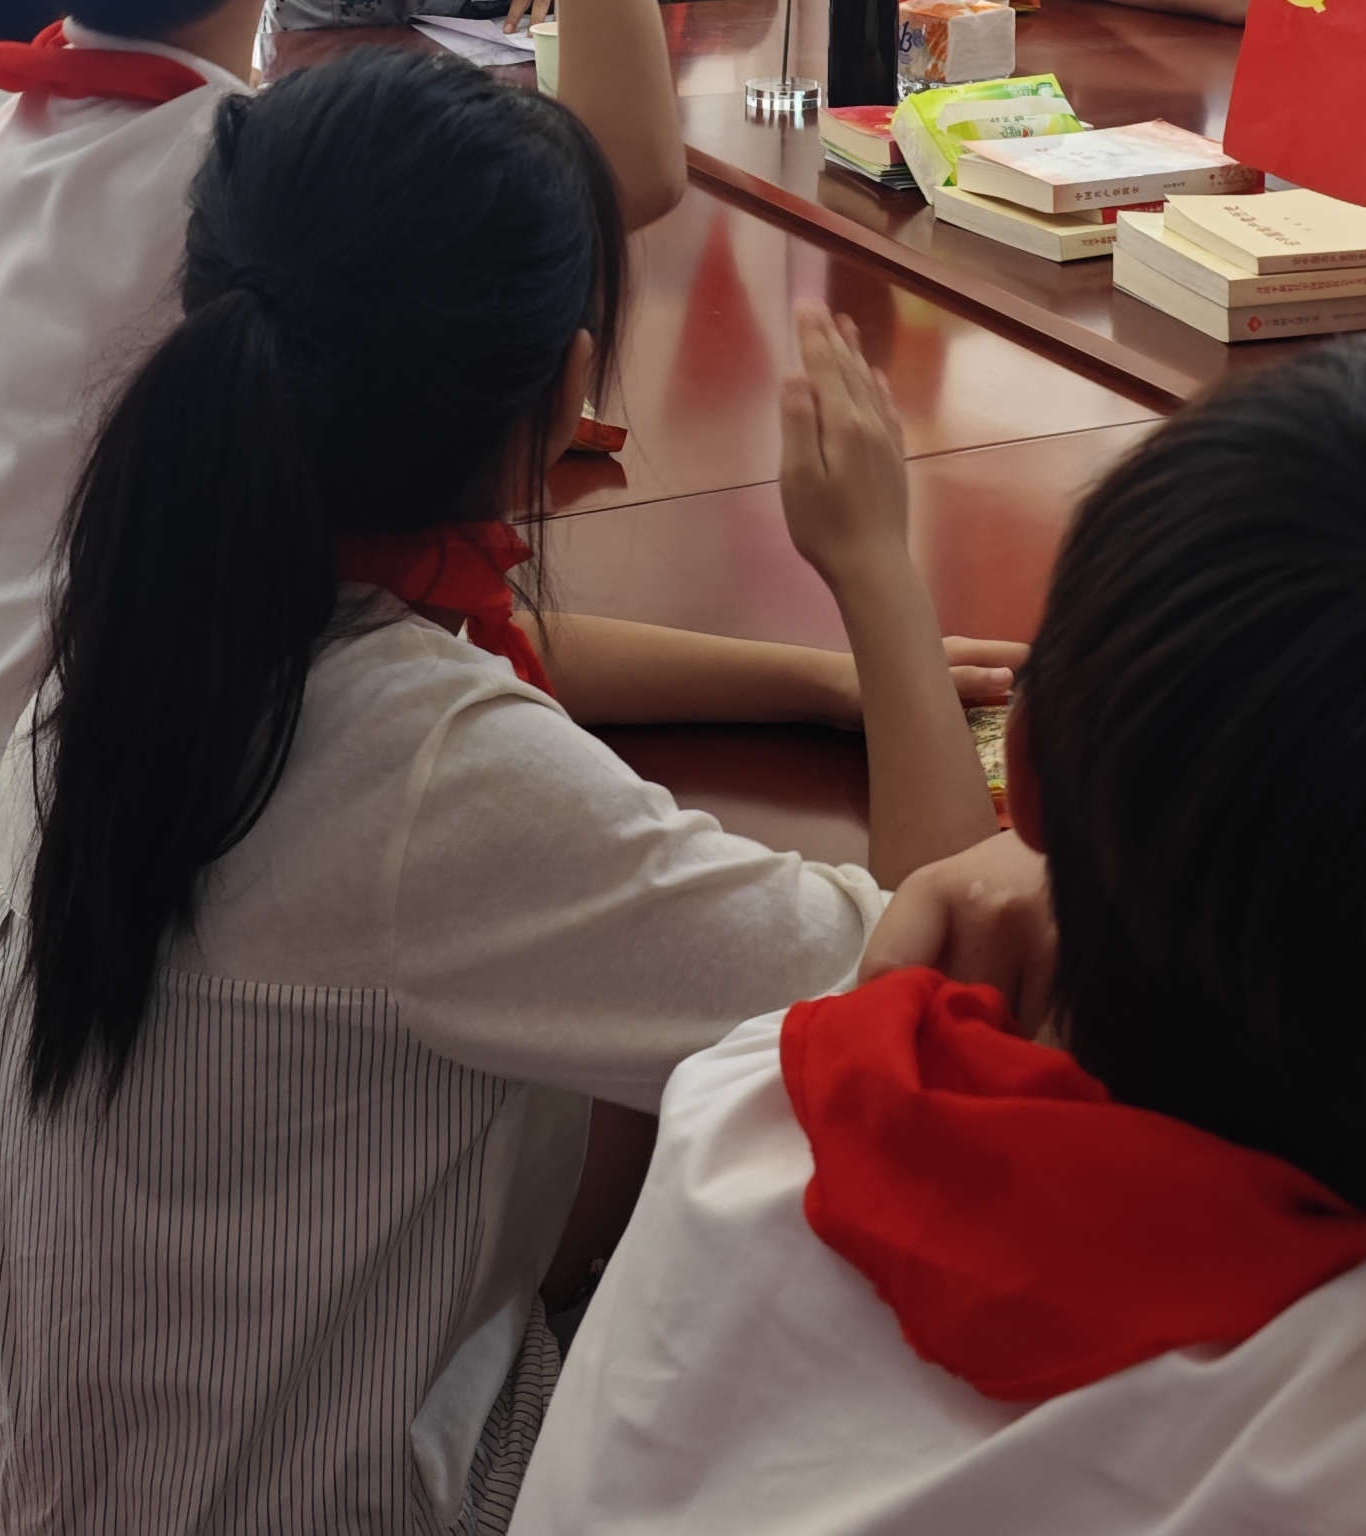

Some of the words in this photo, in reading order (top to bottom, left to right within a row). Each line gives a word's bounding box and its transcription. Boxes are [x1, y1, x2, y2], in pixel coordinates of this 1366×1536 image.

[1075, 185, 1140, 202] 中国共产党简史
